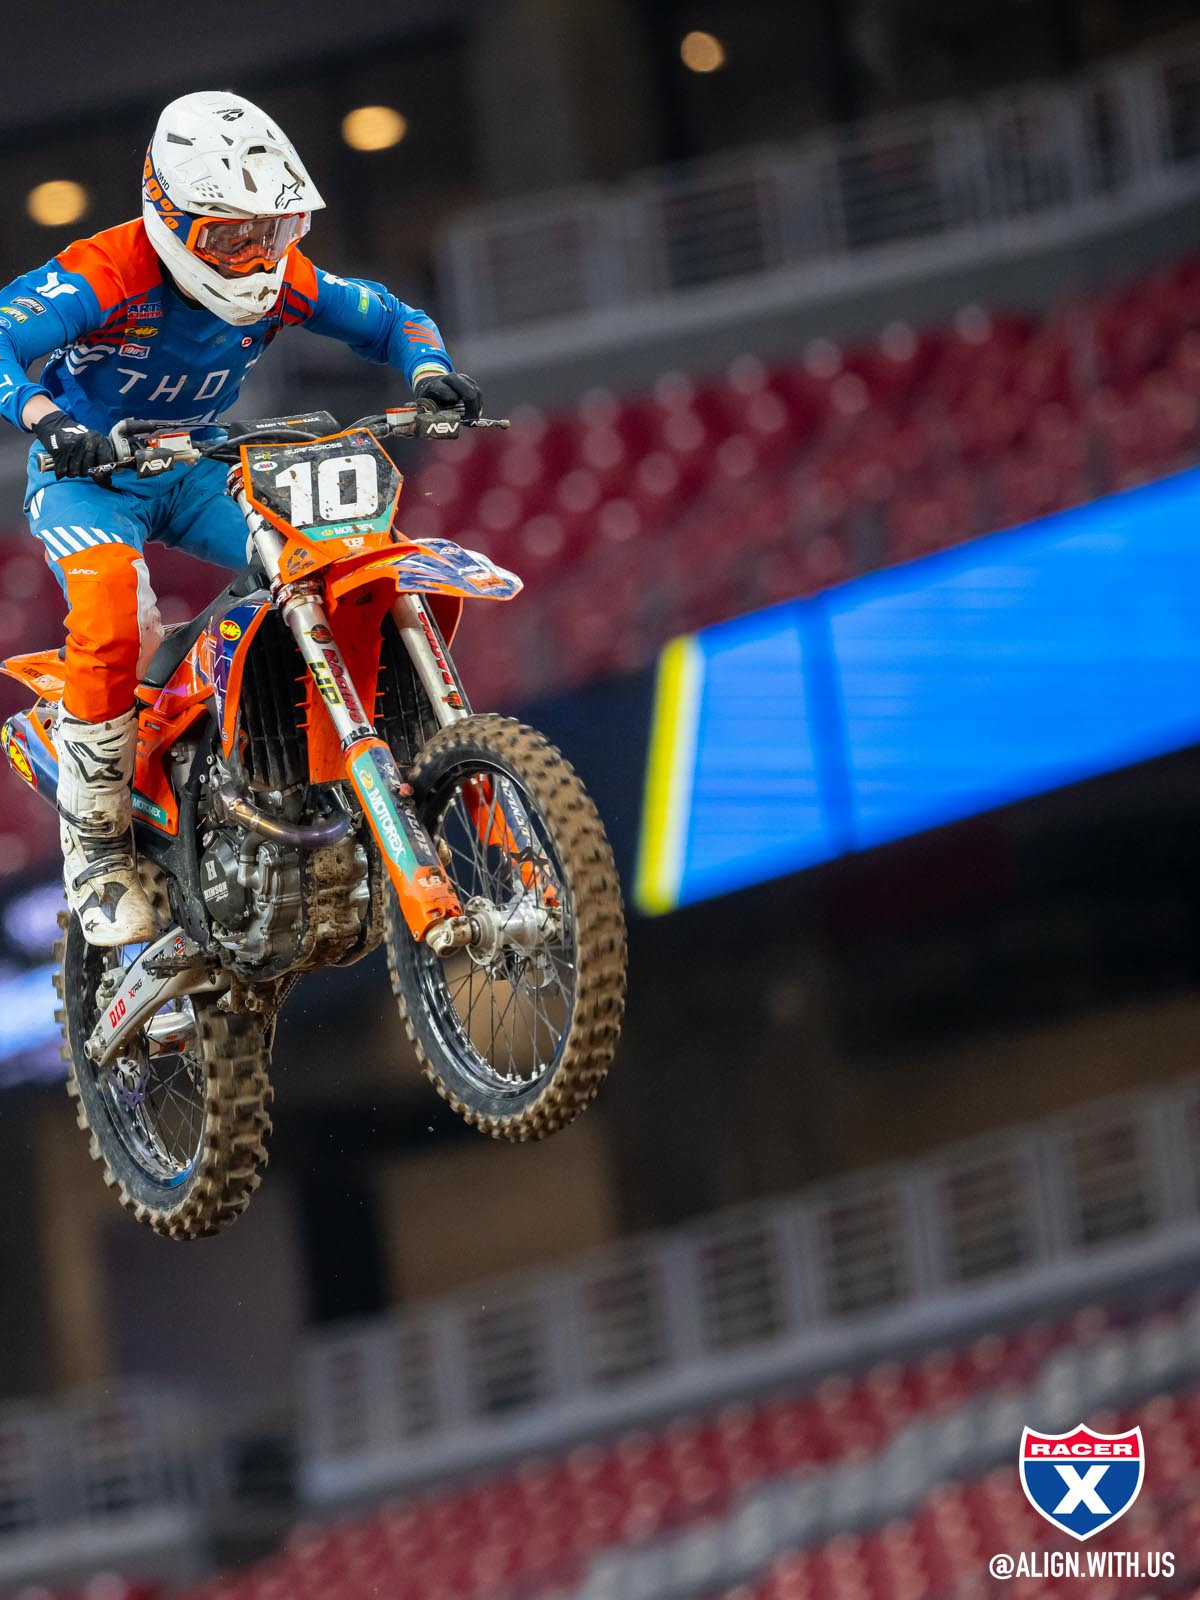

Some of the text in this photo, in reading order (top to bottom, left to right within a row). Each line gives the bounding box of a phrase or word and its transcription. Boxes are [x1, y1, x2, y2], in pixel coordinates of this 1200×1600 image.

[426, 421, 459, 434] ASV
[140, 456, 173, 473] ASV
[275, 453, 378, 527] 10
[308, 660, 342, 706] WP
[322, 648, 365, 724] RACING
[133, 798, 162, 819] MOTOREX
[368, 787, 407, 862] MOTOREX
[203, 881, 228, 900] HINSON
[108, 998, 127, 1029] DID
